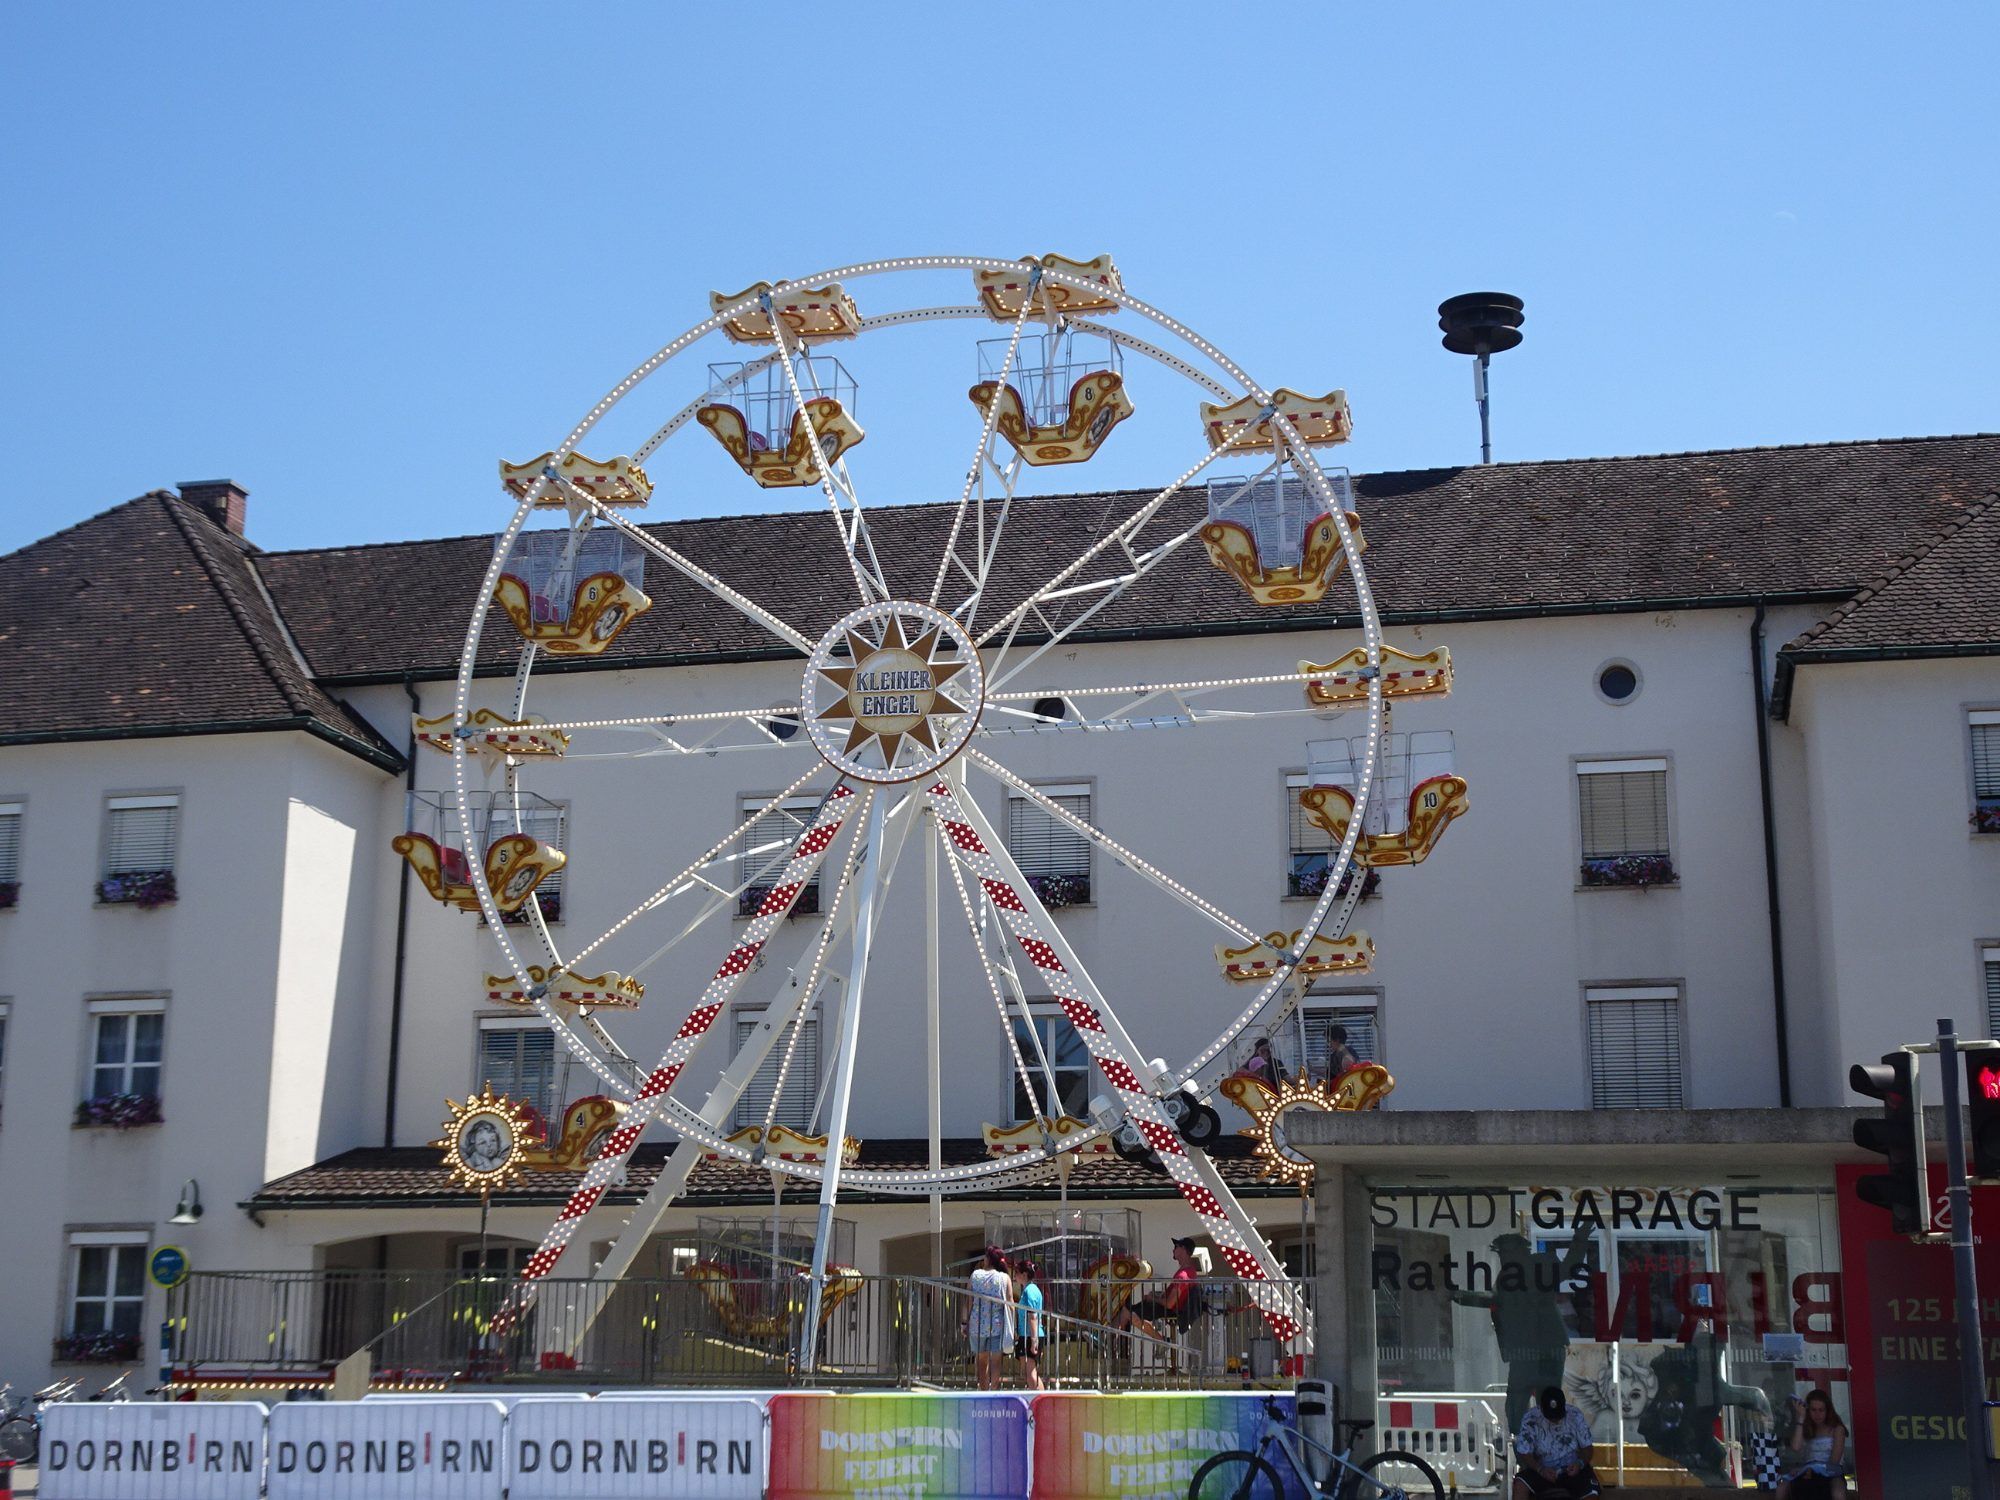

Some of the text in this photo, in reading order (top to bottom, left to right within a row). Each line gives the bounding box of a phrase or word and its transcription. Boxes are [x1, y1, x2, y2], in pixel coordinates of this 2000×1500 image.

[1084, 386, 1093, 401] 8
[1320, 526, 1330, 541] 9
[589, 586, 597, 601] 6
[855, 670, 931, 692] KLEINER
[862, 694, 920, 716] ENGEL
[1423, 791, 1439, 808] 10
[500, 848, 507, 863] 5
[575, 1111, 584, 1126] 4
[1371, 1189, 1761, 1232] STADTGARAGE
[1371, 1251, 1592, 1292] Rathaus
[1888, 1299, 1941, 1321] 125
[1881, 1337, 1947, 1360] EINE
[971, 1409, 1017, 1418] DORNBIRN
[820, 1426, 963, 1453] DORNBIRN
[1083, 1428, 1240, 1456] DORNBIRN
[49, 1432, 255, 1474] DORNBIRN
[276, 1431, 495, 1475] DORNBIRN
[519, 1431, 753, 1476] DORNBIRN
[844, 1455, 938, 1480] FEIERT
